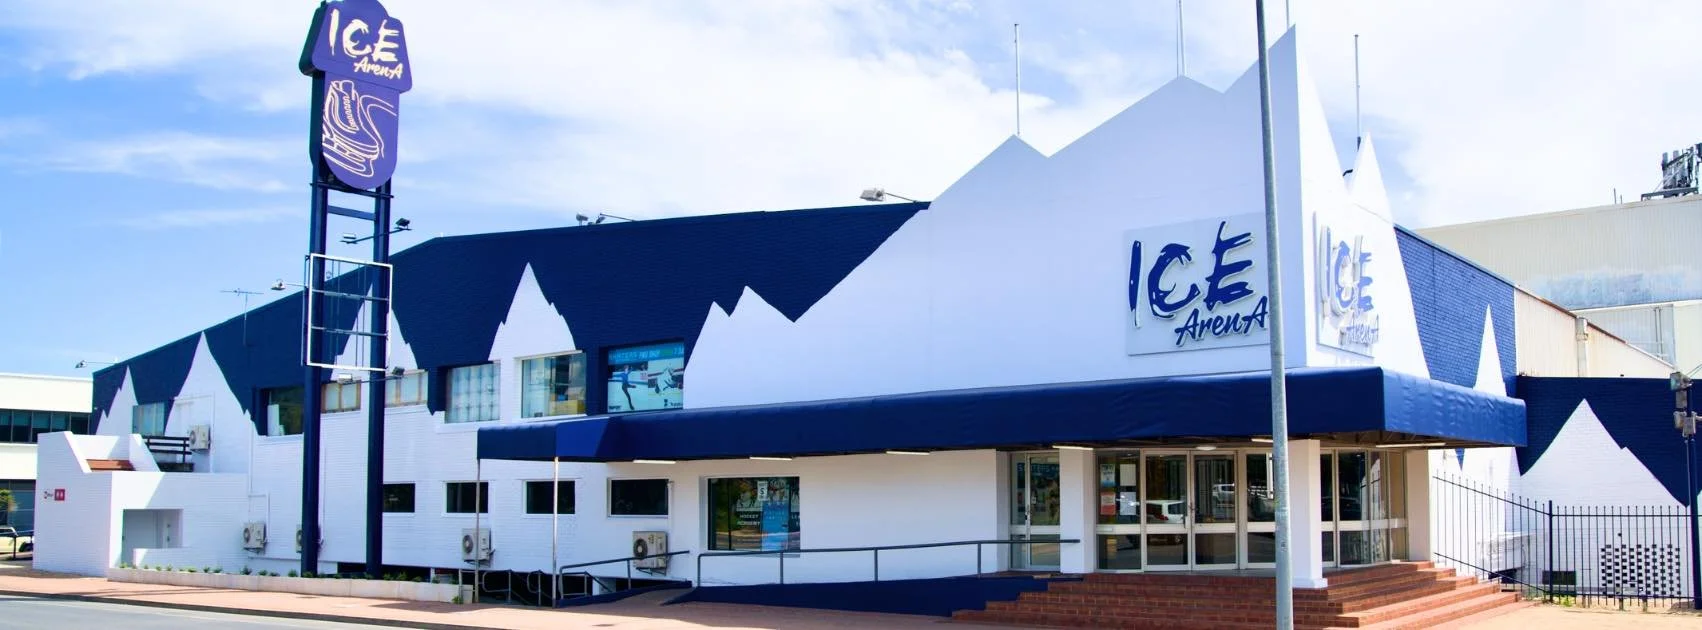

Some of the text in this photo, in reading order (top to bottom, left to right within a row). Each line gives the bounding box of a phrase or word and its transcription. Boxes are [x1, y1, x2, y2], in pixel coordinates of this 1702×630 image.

[329, 9, 399, 62] ICE
[1128, 220, 1254, 322] ICE
[1320, 224, 1374, 317] ICE
